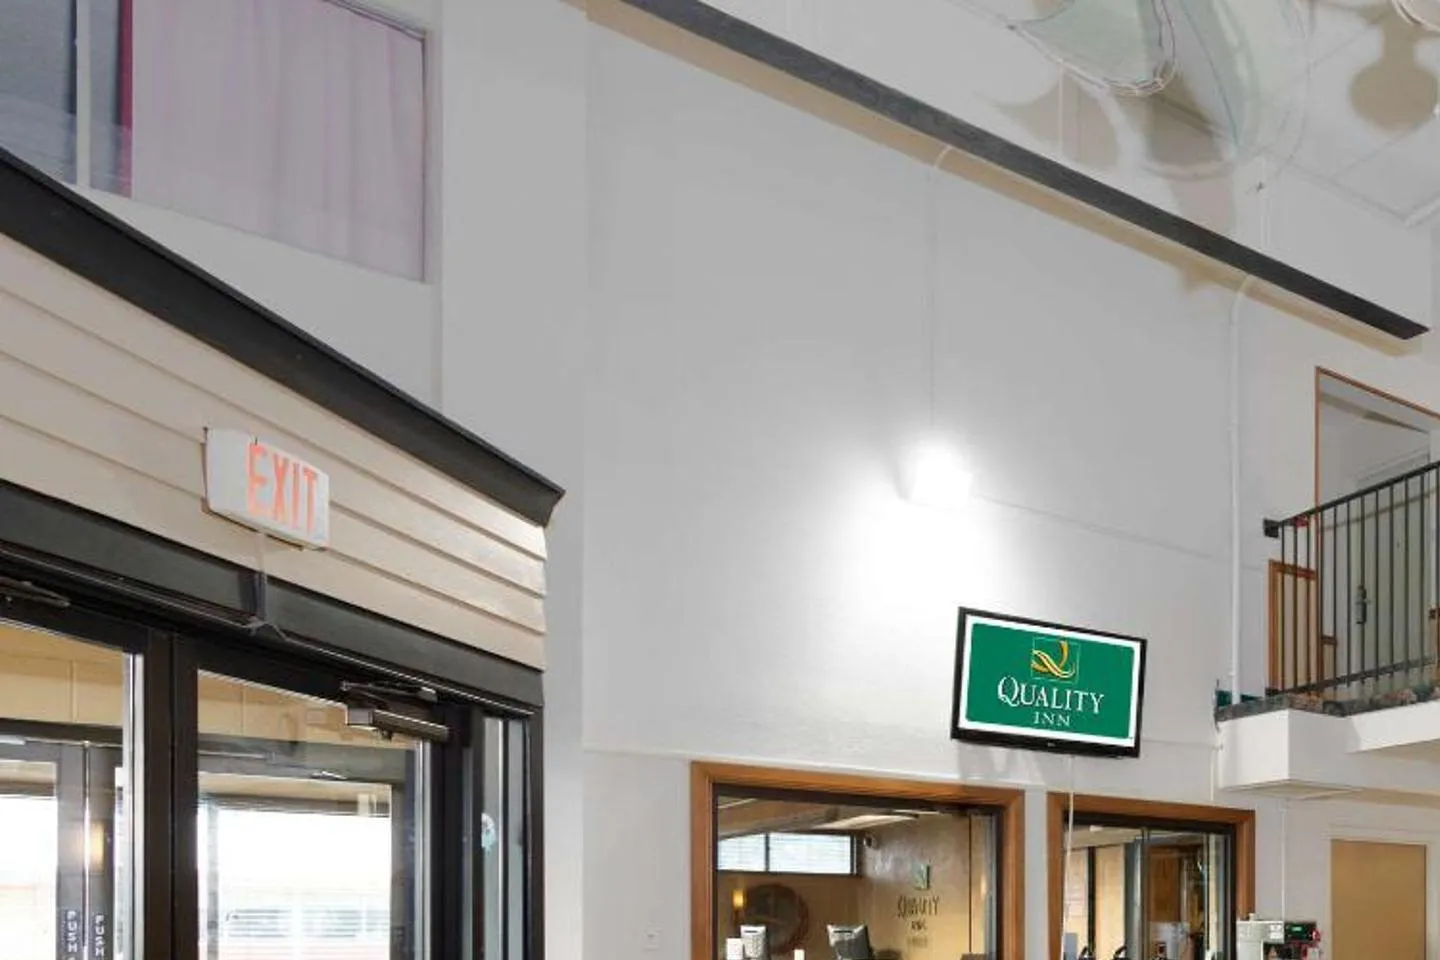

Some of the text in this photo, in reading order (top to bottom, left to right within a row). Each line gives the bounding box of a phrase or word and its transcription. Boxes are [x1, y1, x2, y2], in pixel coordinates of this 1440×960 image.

[247, 443, 318, 531] EXIT
[997, 675, 1104, 714] QUALITY
[1033, 711, 1070, 727] INN
[67, 910, 78, 953] PUSH
[95, 914, 105, 957] PUSH
